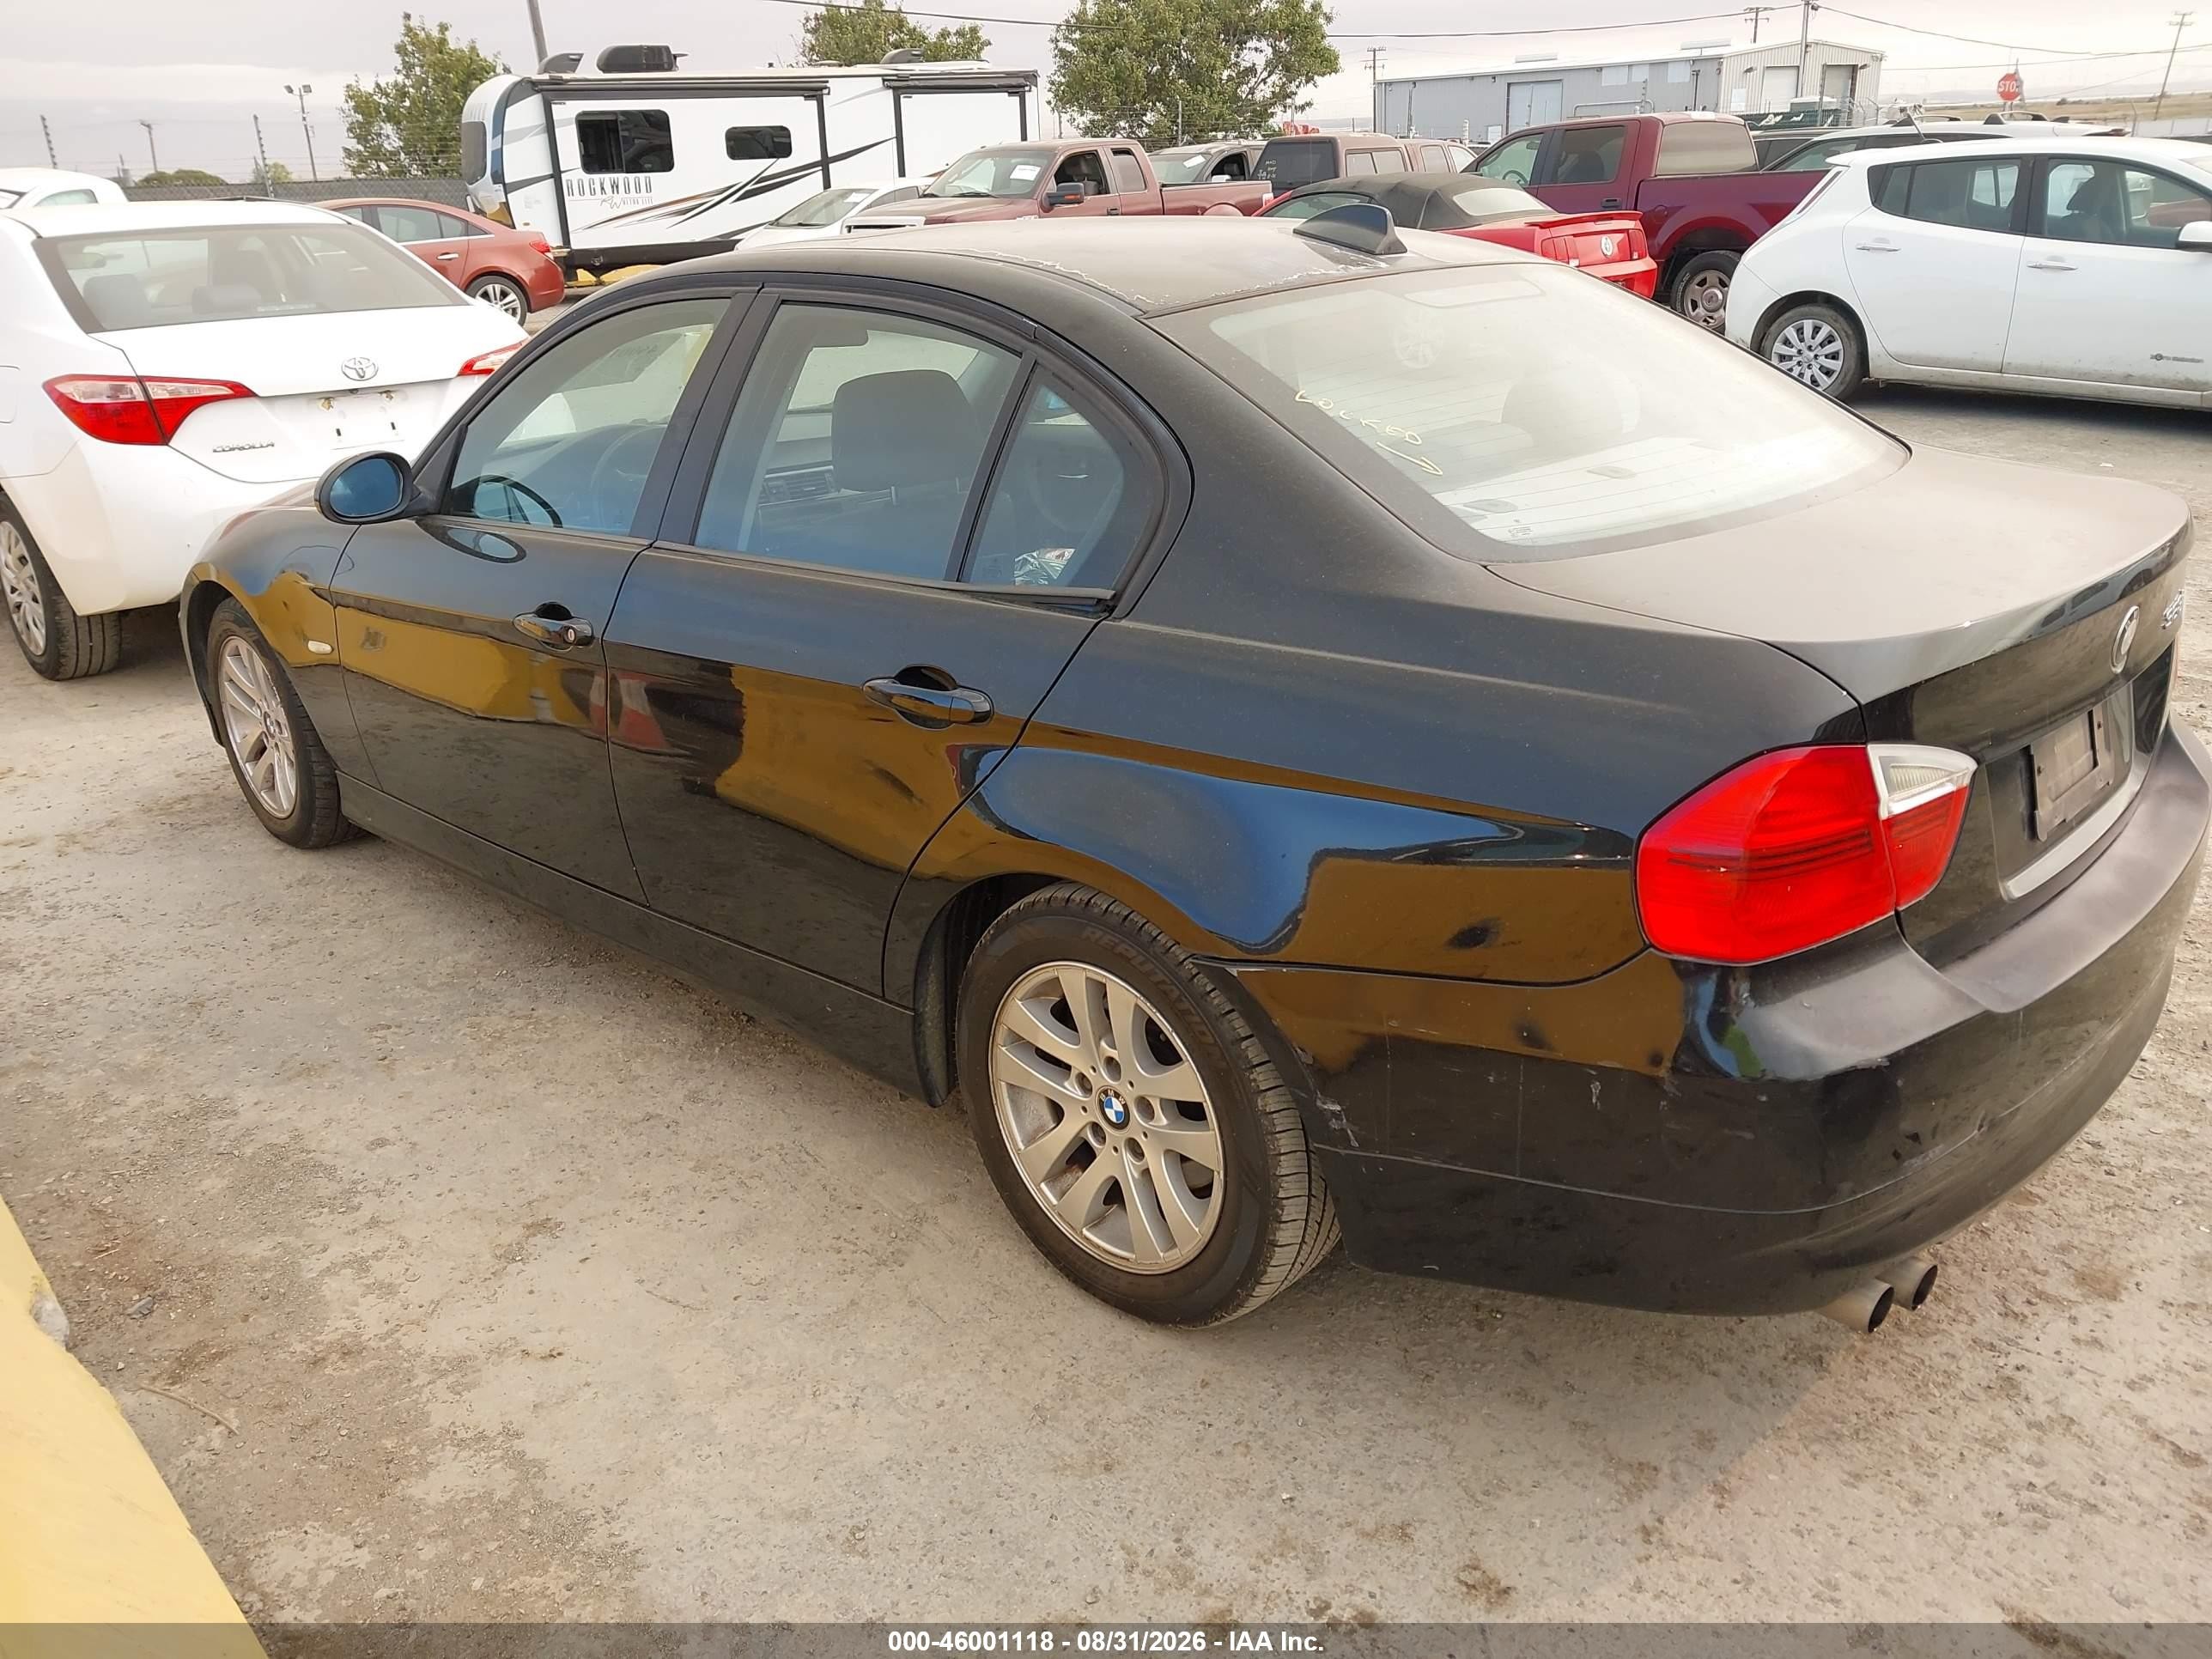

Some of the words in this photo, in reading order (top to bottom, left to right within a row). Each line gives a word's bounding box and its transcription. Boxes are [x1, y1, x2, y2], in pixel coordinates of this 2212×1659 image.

[565, 176, 653, 198] ROCKWOOD
[1294, 389, 1423, 446] LOCKED
[212, 440, 275, 453] COROLLA
[1099, 1089, 1126, 1105] BMW
